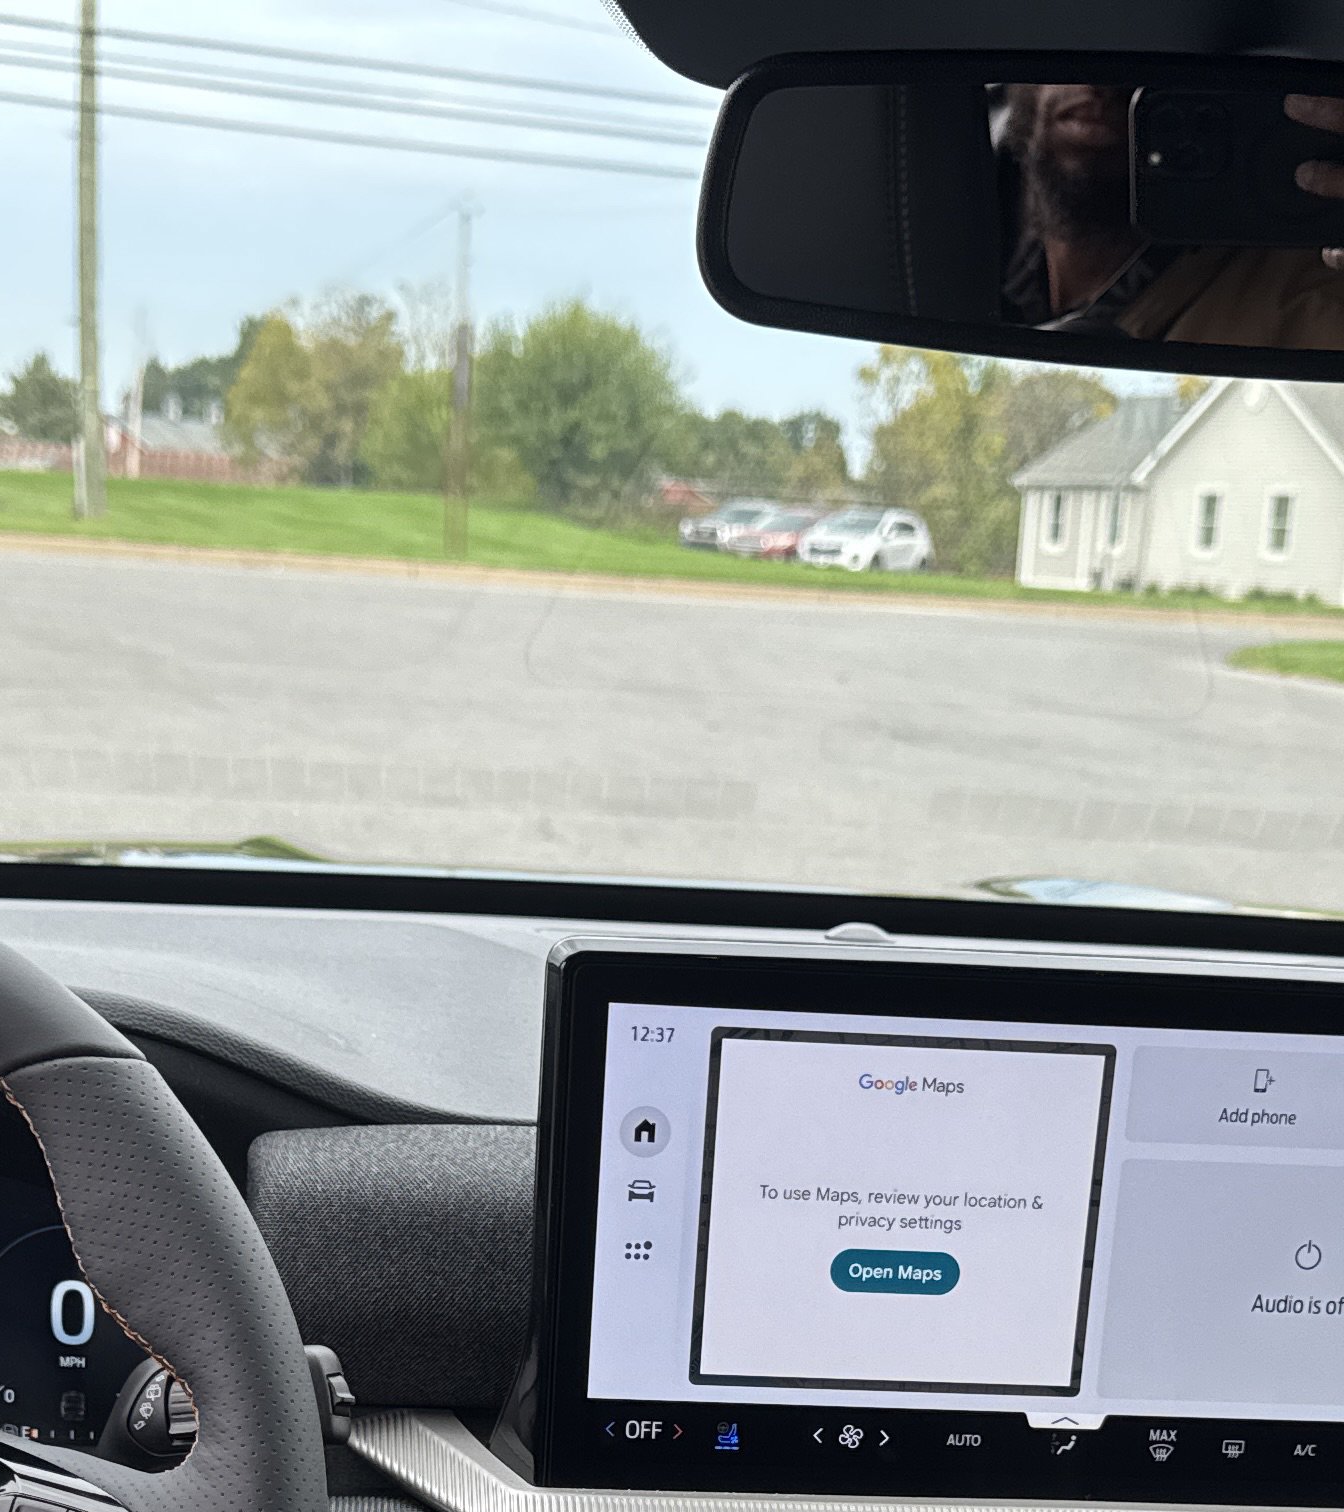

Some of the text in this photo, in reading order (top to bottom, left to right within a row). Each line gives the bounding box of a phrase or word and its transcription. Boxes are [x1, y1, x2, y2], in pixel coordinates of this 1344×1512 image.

[630, 1025, 676, 1044] 12:37
[859, 1073, 965, 1096] Google Maps
[1218, 1108, 1297, 1127] Add phone
[759, 1184, 1044, 1210] To use Maps, review your location &
[838, 1212, 963, 1234] privacy settings
[848, 1263, 943, 1285] Open Maps
[50, 1279, 95, 1345] 0
[1251, 1293, 1304, 1315] Audio
[1308, 1295, 1322, 1315] is
[59, 1356, 86, 1369] MPH
[3, 1388, 16, 1404] 0
[624, 1420, 663, 1440] OFF
[1148, 1428, 1178, 1443] MAX
[947, 1433, 982, 1447] AUTO
[1293, 1443, 1317, 1458] A/C
